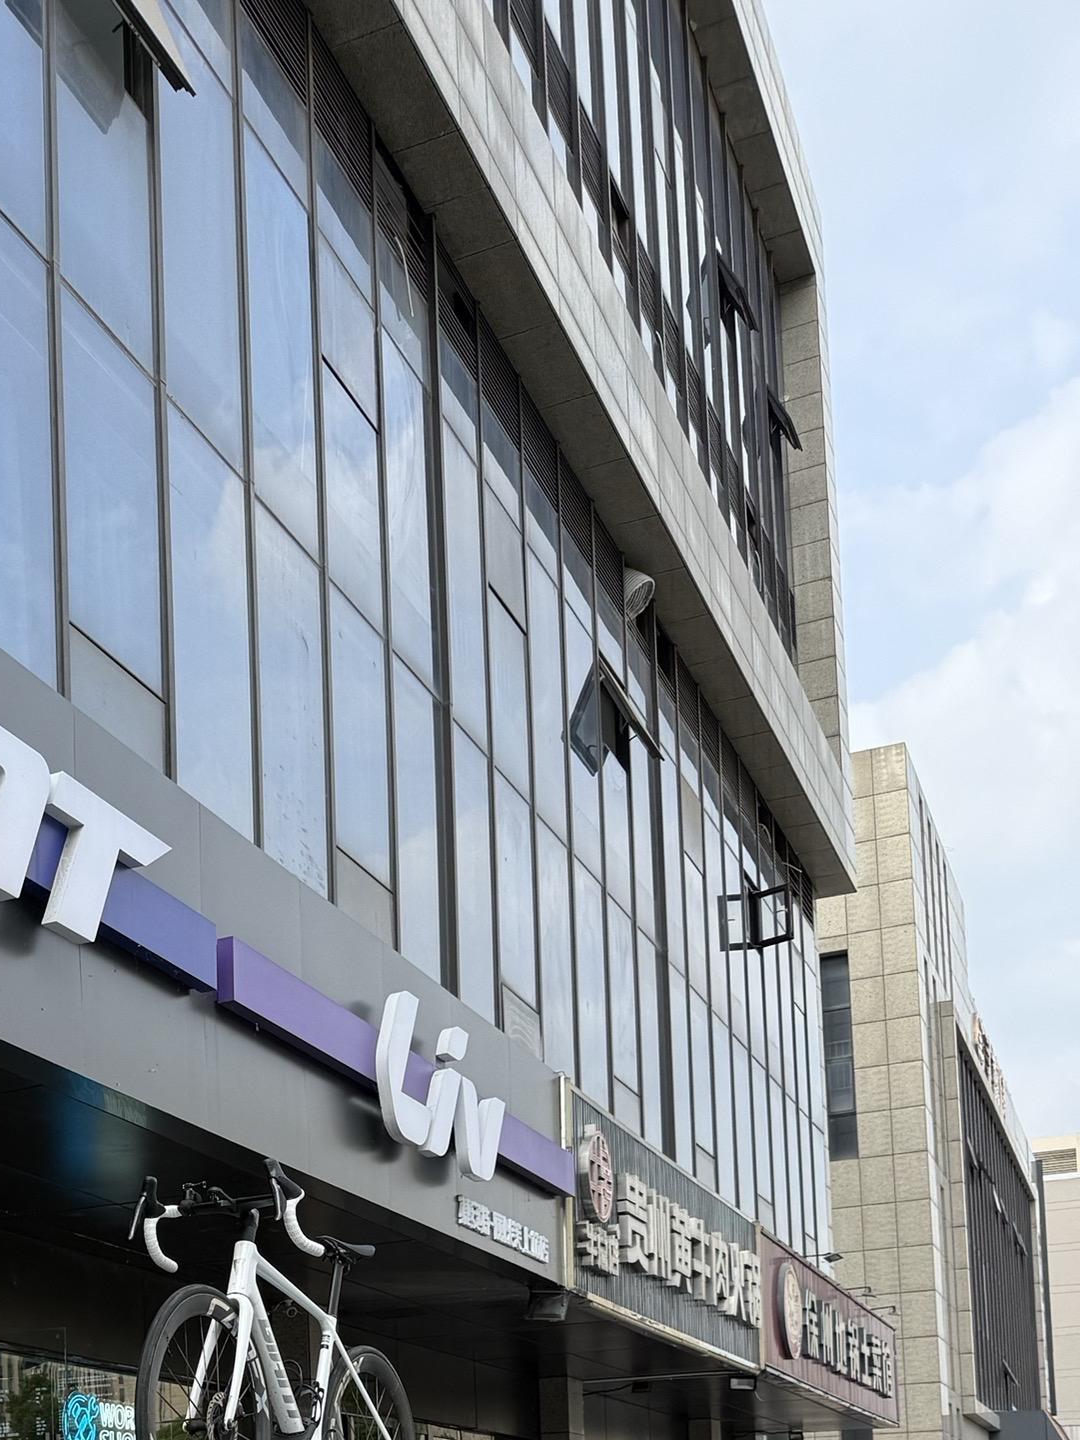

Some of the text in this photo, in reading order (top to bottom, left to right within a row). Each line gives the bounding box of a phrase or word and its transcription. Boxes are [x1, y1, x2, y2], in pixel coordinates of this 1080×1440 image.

[375, 990, 506, 1182] Liv
[617, 1171, 762, 1329] 贵州黄牛肉火锅
[804, 1287, 894, 1398] 徐州地锅土菜馆
